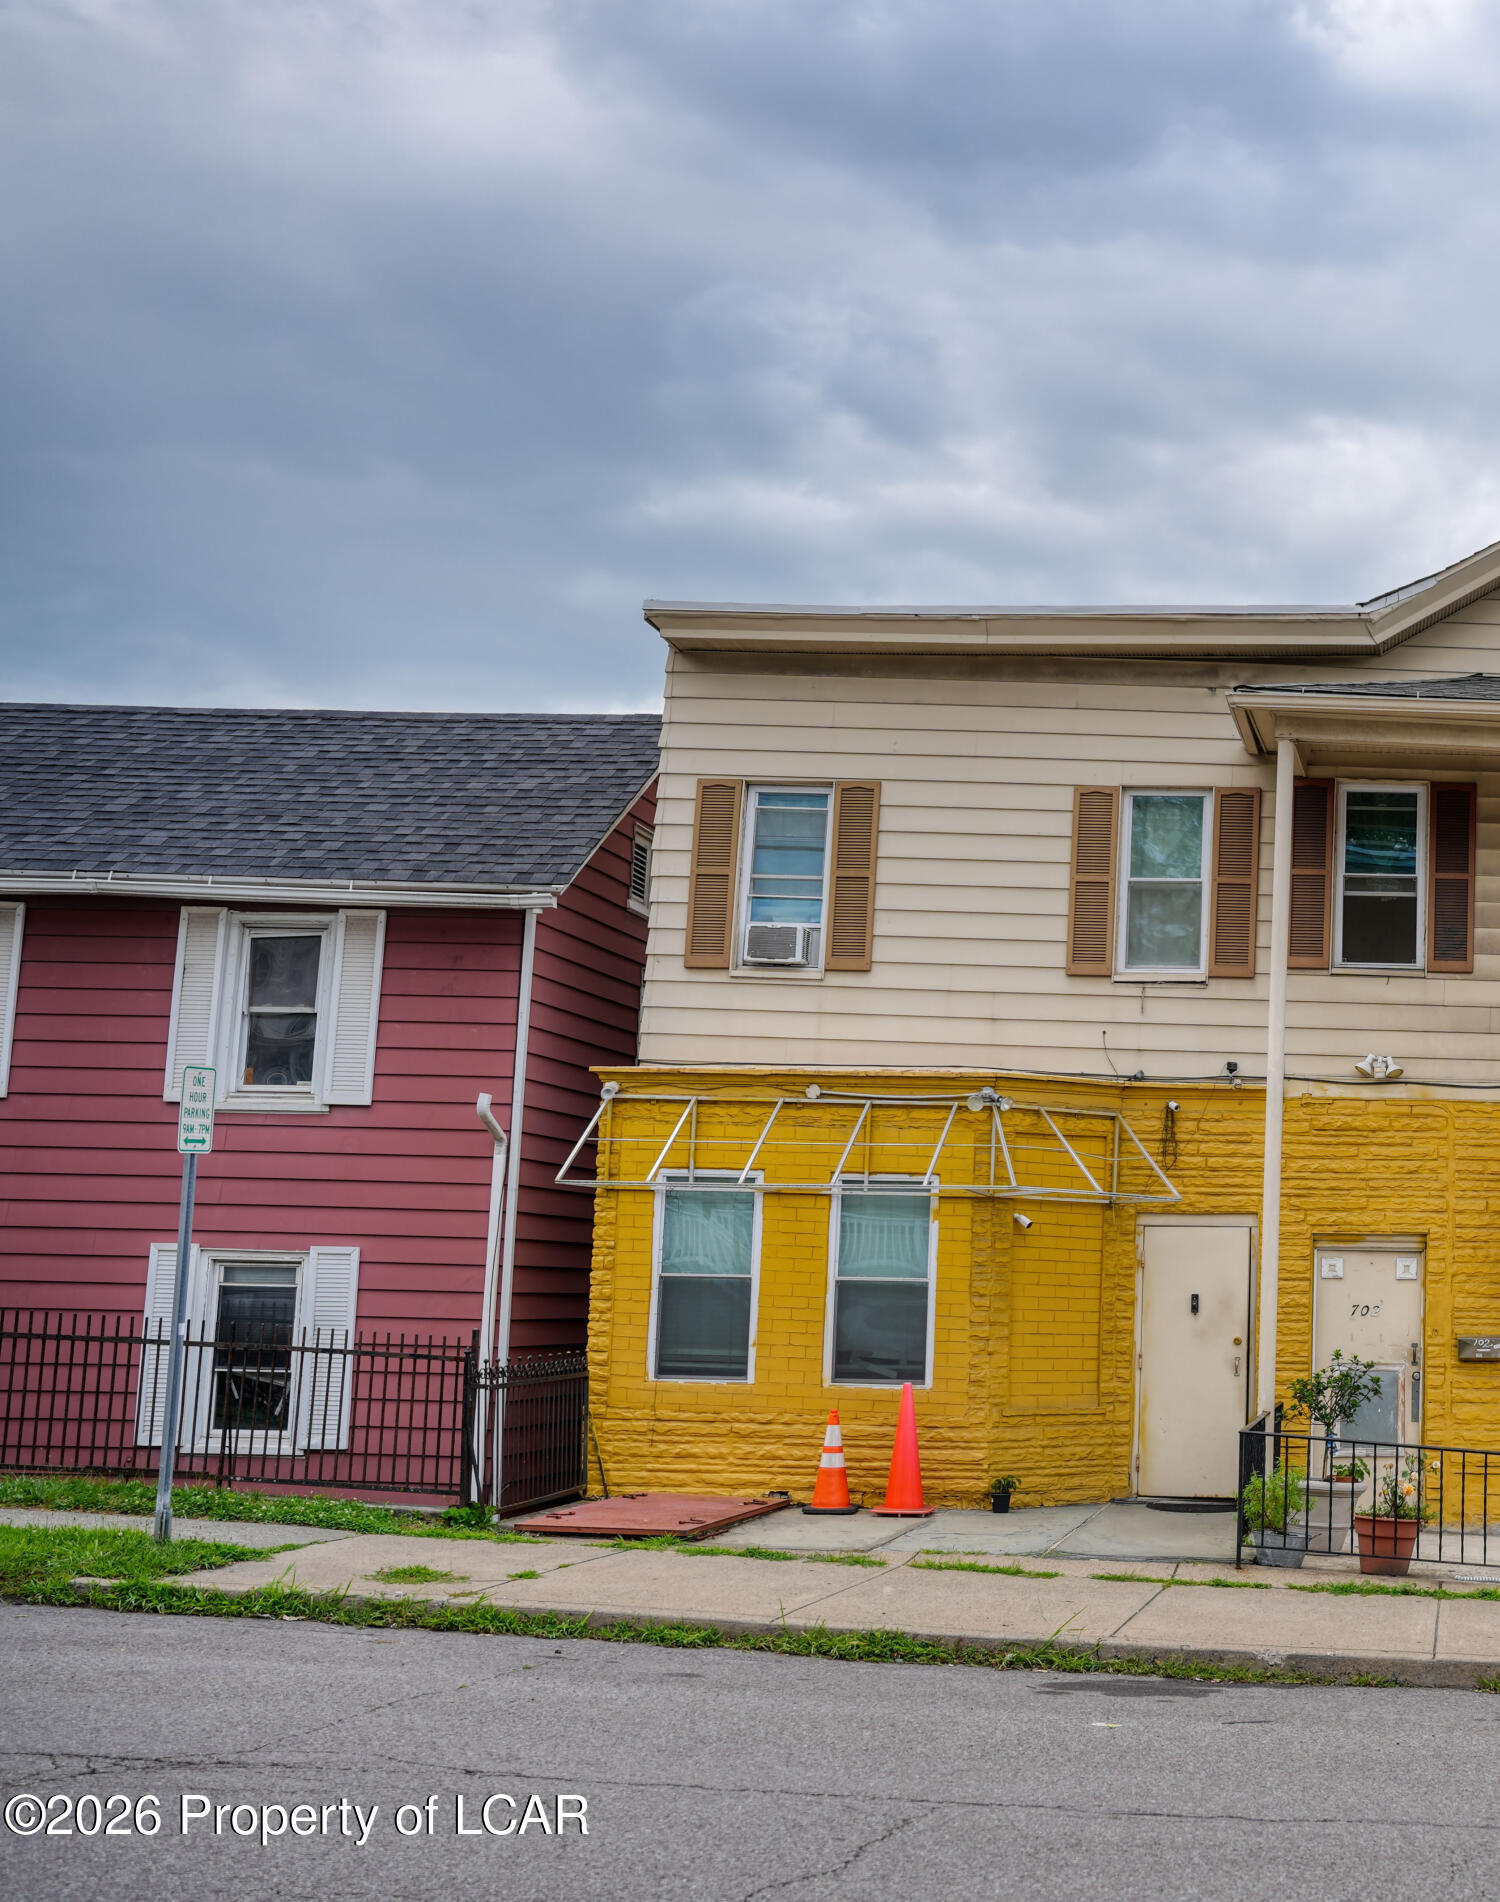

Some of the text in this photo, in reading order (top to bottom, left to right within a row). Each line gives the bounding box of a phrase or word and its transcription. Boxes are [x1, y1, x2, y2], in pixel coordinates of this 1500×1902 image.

[192, 1075, 206, 1087] ONE
[189, 1092, 207, 1103] HOUR
[183, 1107, 210, 1119] PARKING
